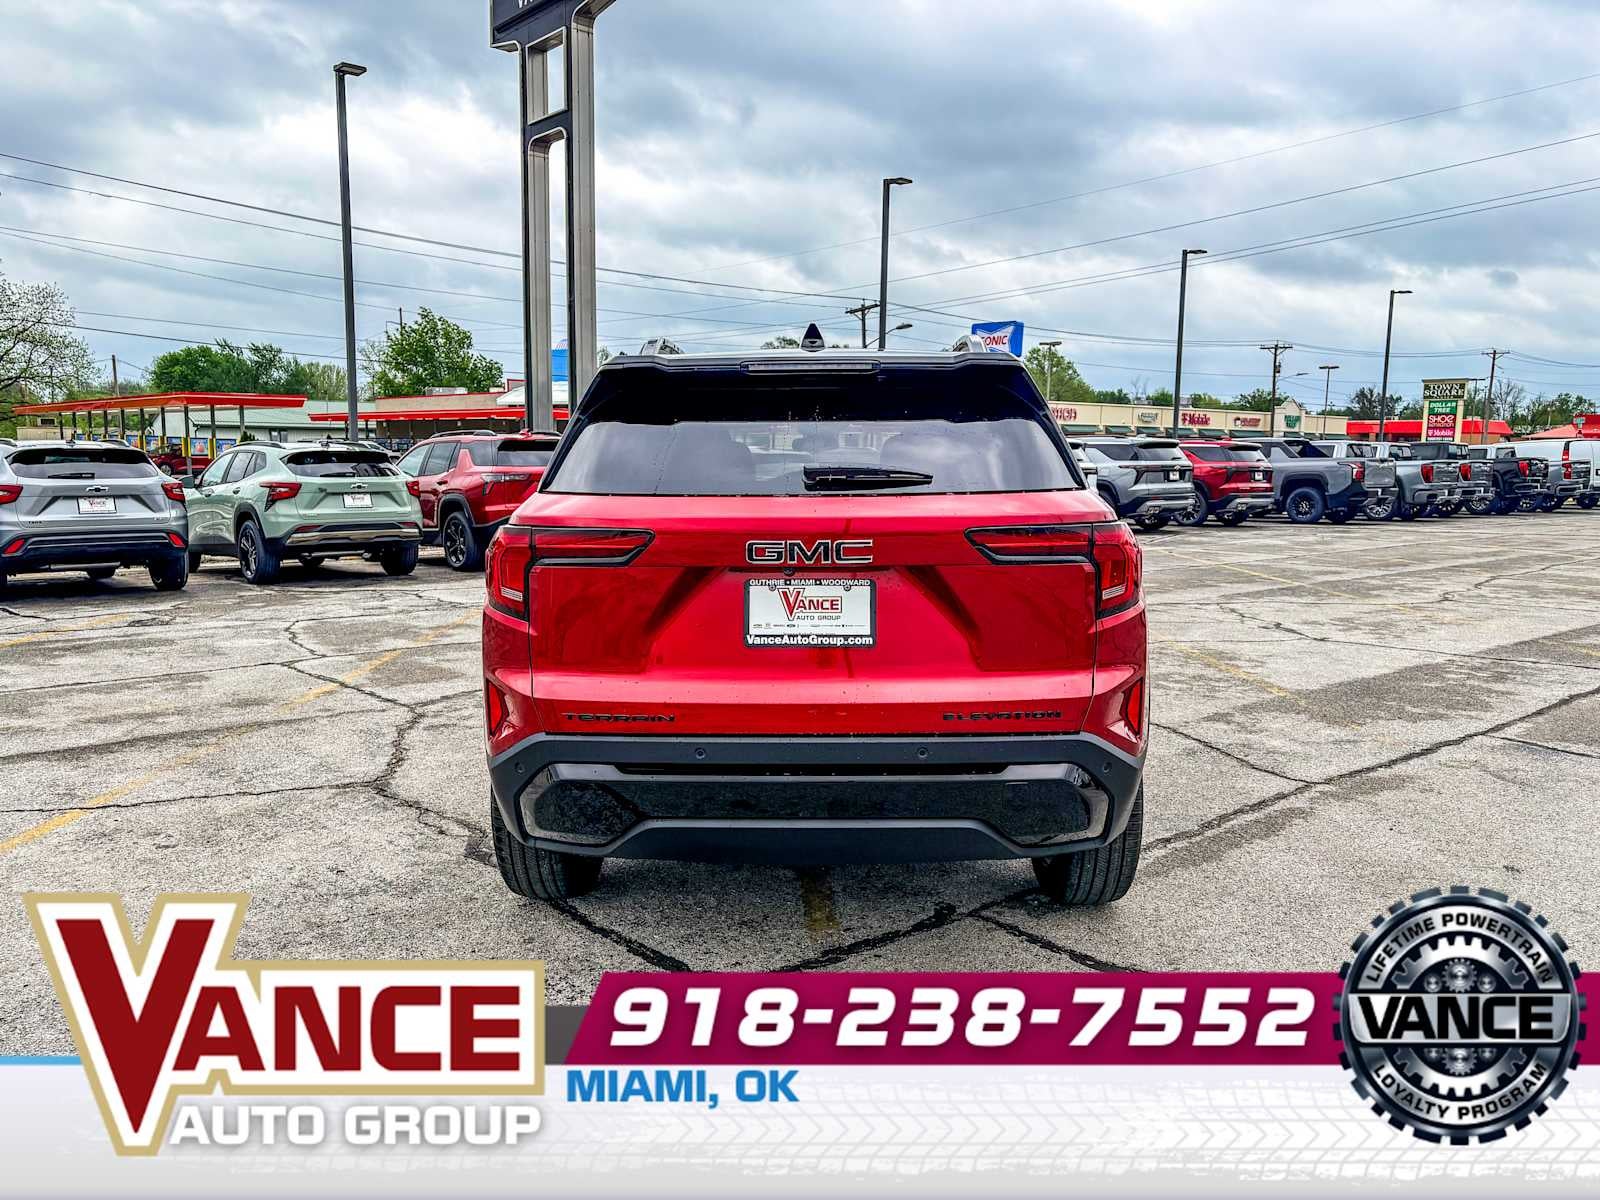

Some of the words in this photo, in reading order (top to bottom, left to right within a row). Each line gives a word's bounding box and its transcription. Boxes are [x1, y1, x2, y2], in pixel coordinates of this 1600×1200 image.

[981, 336, 1007, 346] ONIC
[1424, 389, 1464, 397] SQUARE
[745, 539, 874, 565] GMC
[779, 588, 842, 620] VANCE
[746, 634, 874, 646] VanceAutoGroup.com
[561, 711, 676, 722] TERRAIN
[942, 710, 1062, 721] ELEVATION
